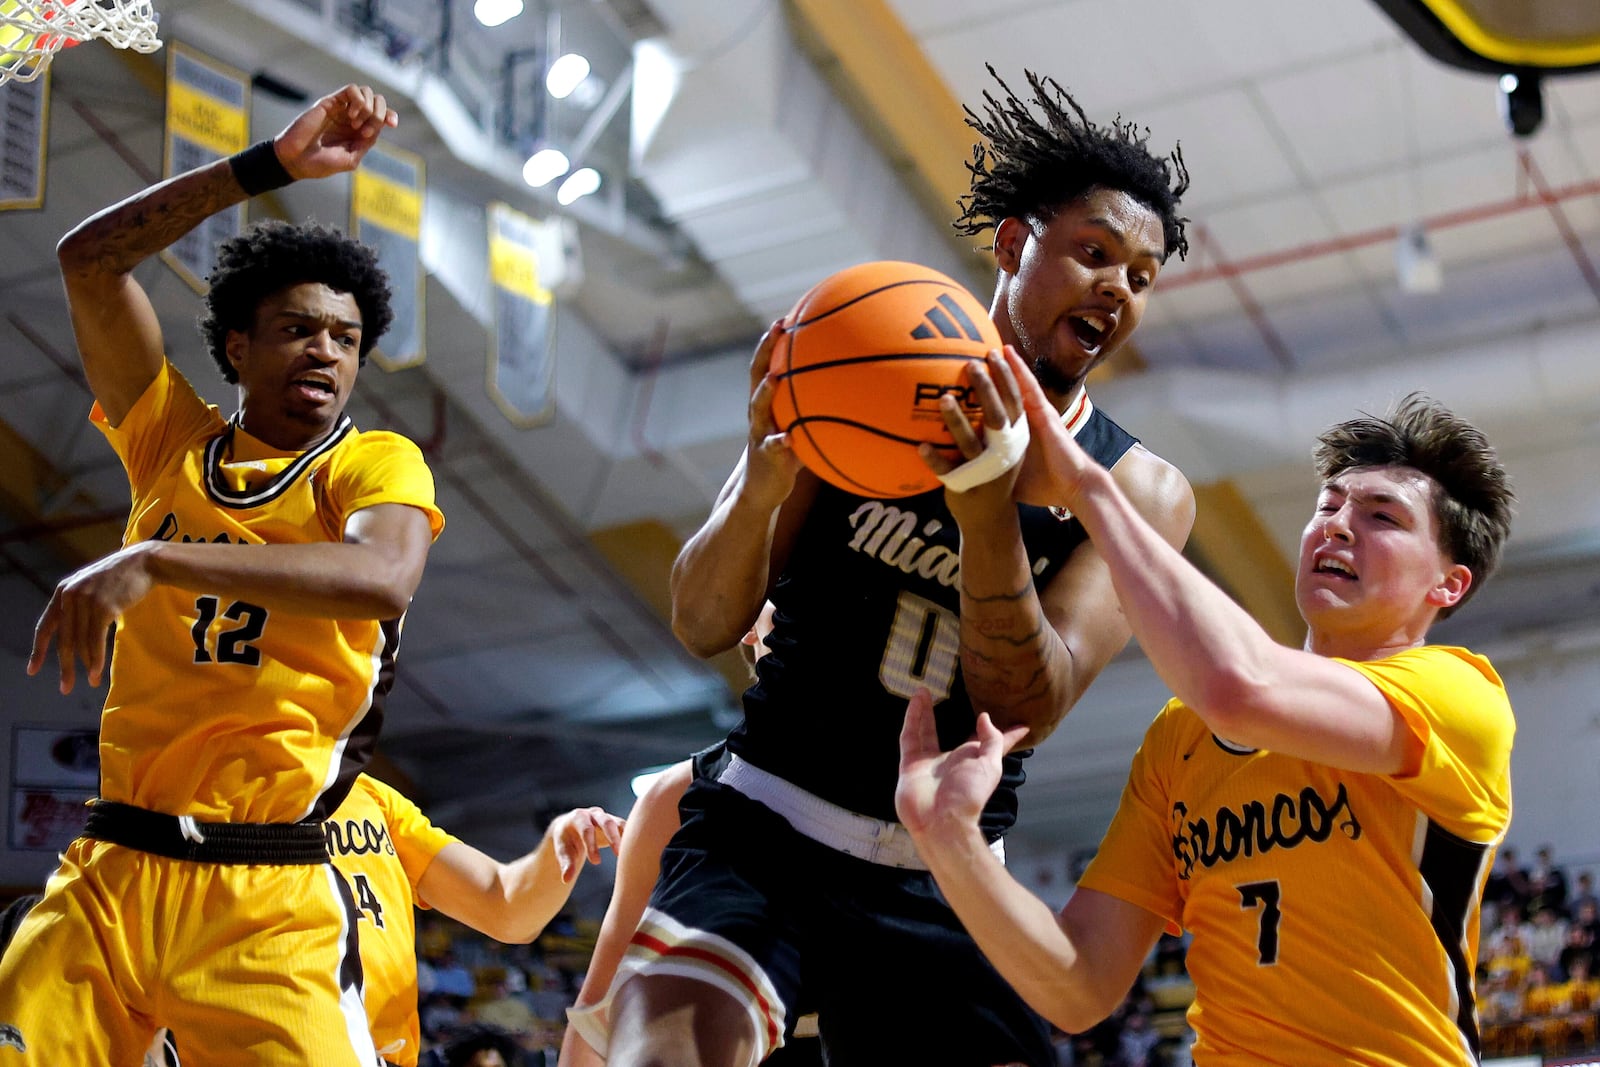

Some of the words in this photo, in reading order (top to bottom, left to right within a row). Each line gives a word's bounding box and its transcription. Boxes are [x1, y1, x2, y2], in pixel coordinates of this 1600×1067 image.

[847, 500, 1050, 592] Mia
[192, 593, 270, 668] 12
[878, 590, 961, 707] 0
[325, 818, 394, 857] ncos
[1171, 782, 1362, 881] Broncos
[353, 874, 386, 930] 4
[1234, 879, 1282, 968] 7
